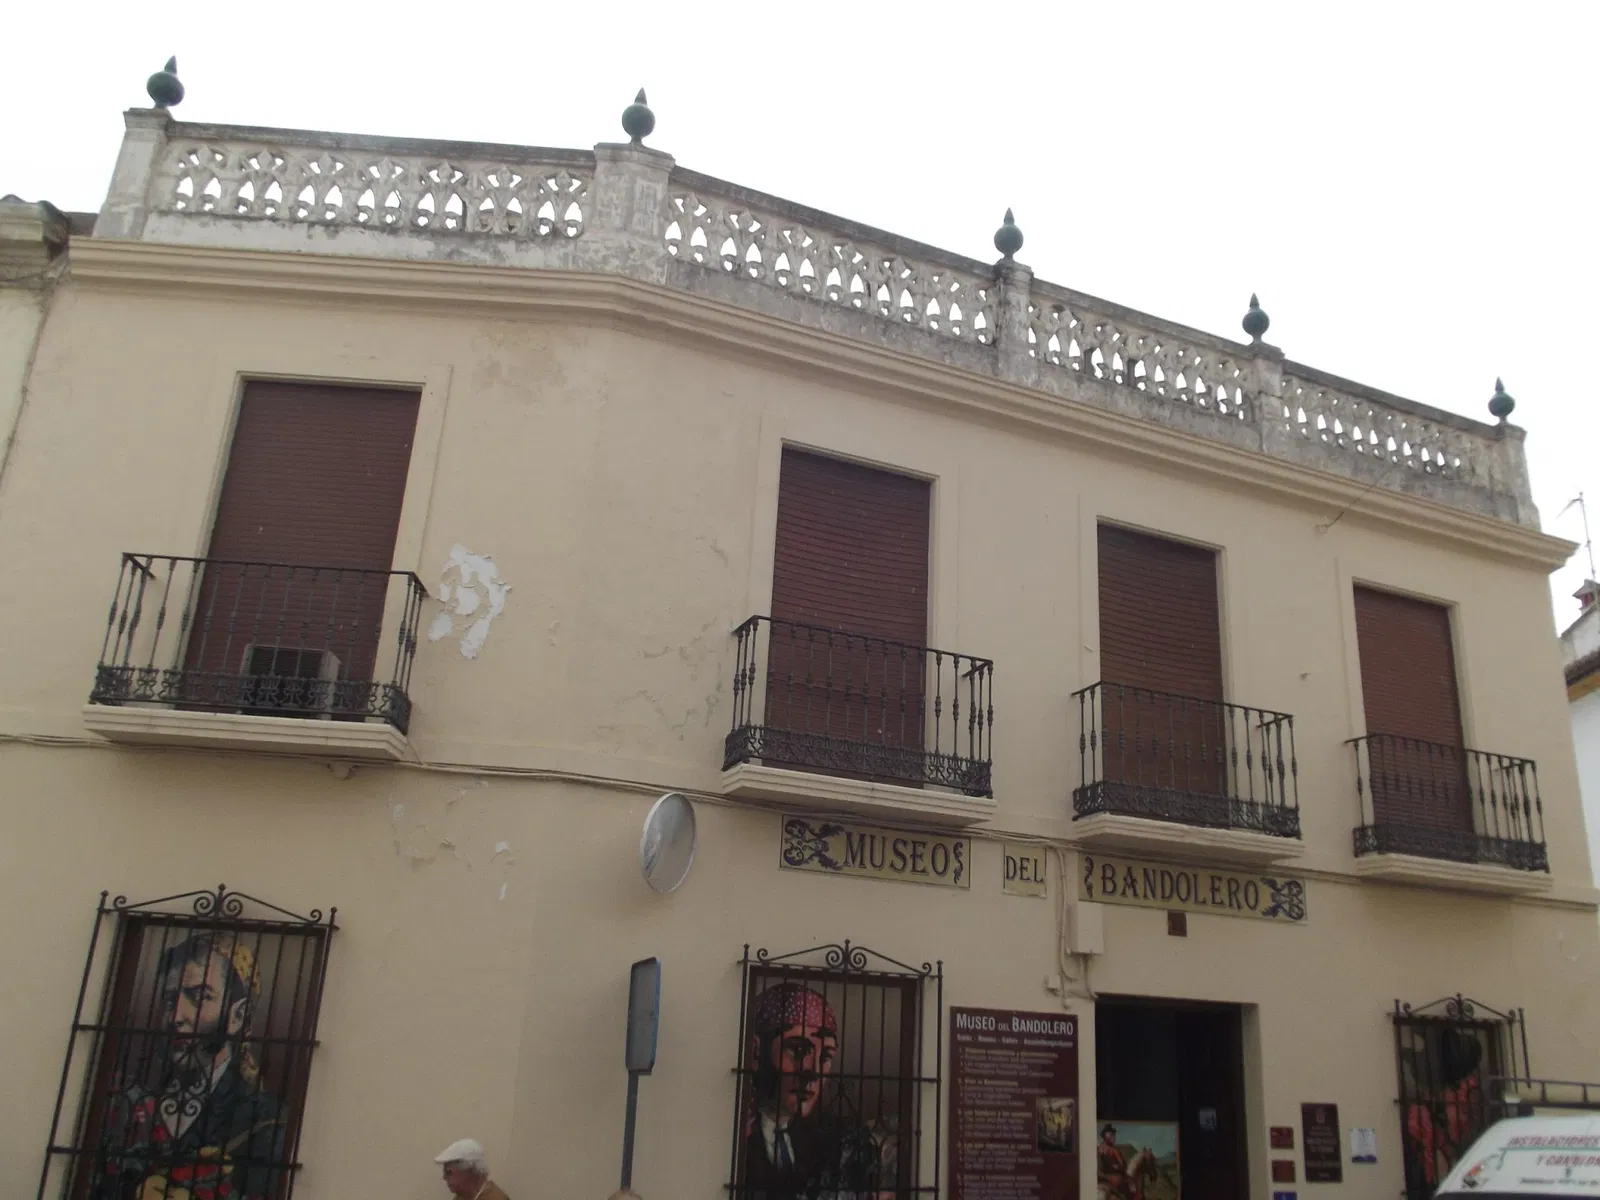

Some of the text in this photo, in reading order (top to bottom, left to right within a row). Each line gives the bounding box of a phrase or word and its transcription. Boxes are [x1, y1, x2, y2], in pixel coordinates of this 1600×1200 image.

[845, 831, 1259, 911] MUSEO DEL BANDOLERO
[956, 1013, 996, 1031] MUSEO
[1012, 1016, 1074, 1036] BANDOLERO
